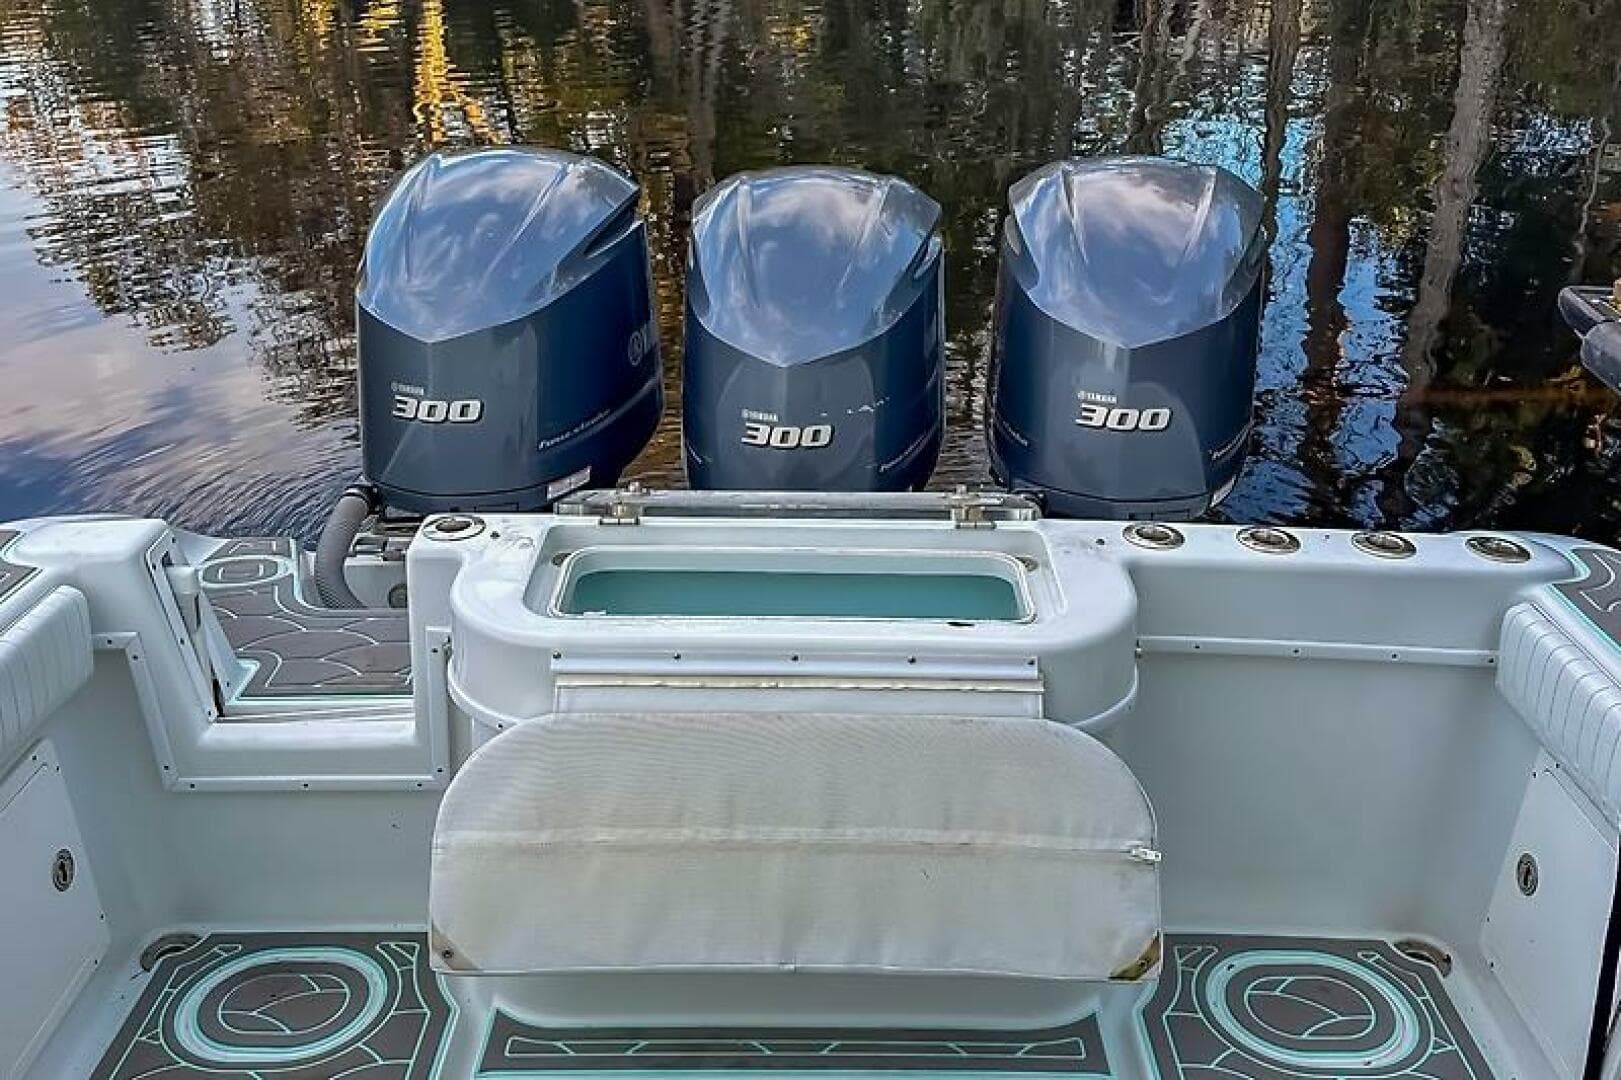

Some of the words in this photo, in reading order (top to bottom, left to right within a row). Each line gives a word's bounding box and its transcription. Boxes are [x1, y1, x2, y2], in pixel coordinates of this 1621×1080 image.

[392, 395, 482, 422] 300
[1075, 403, 1170, 431] 300
[741, 422, 832, 448] 300
